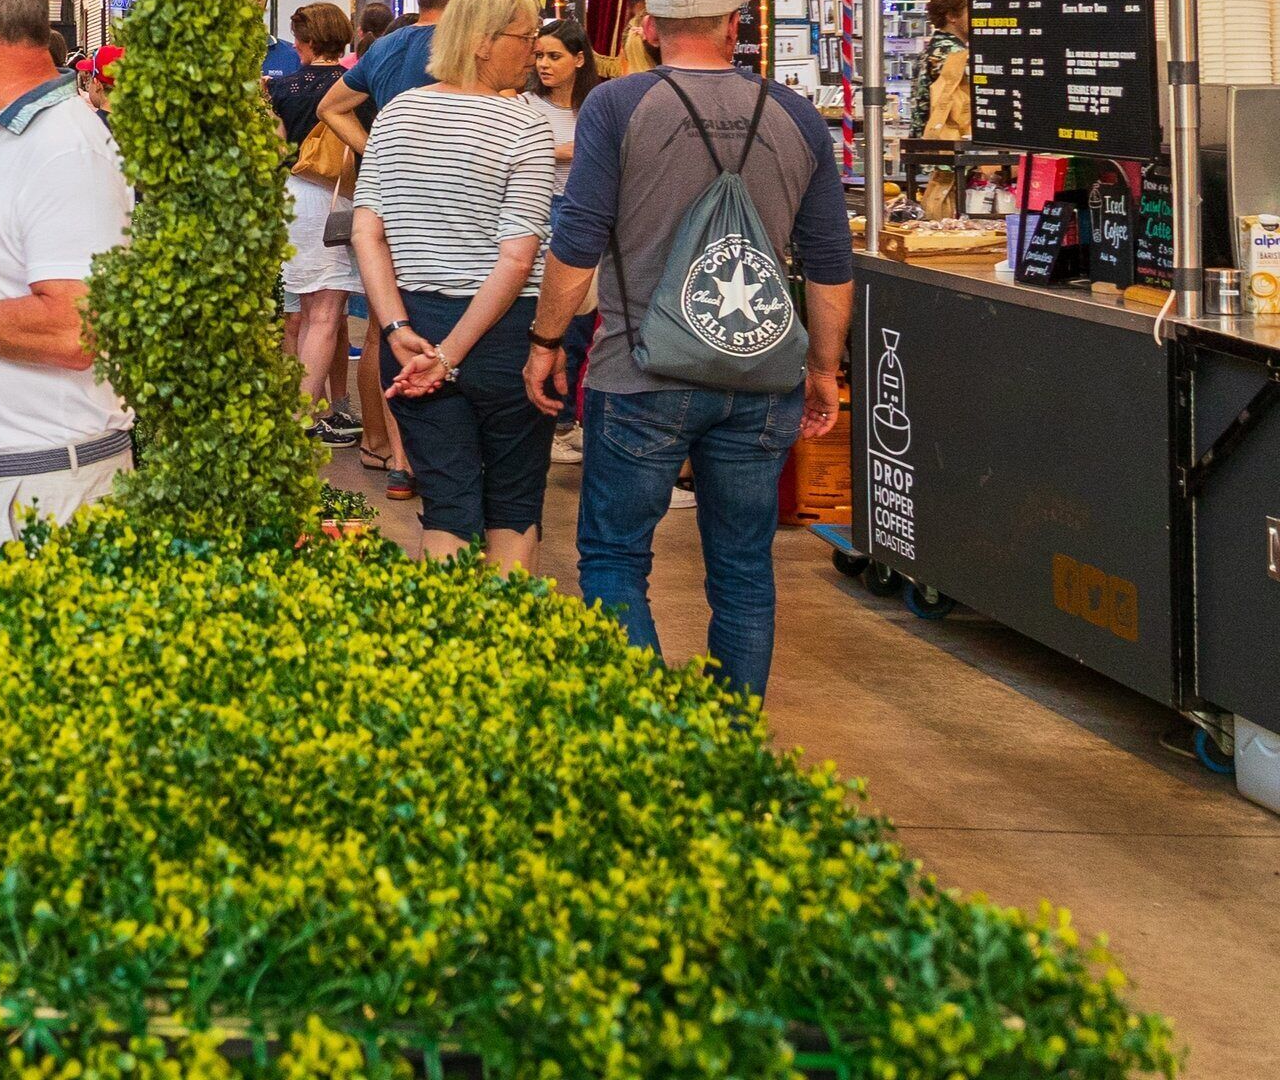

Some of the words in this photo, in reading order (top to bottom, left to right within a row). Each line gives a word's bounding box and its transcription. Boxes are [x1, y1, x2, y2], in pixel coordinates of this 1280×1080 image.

[1104, 195, 1127, 216] Iced
[1104, 219, 1129, 249] Coffee
[753, 297, 785, 314] Taylor
[696, 311, 727, 341] ALL
[733, 318, 778, 346] STAR
[873, 459, 913, 494] DROP
[874, 484, 914, 518] HOPPER
[875, 506, 914, 541] COFFEE
[875, 528, 915, 560] ROASTERS
